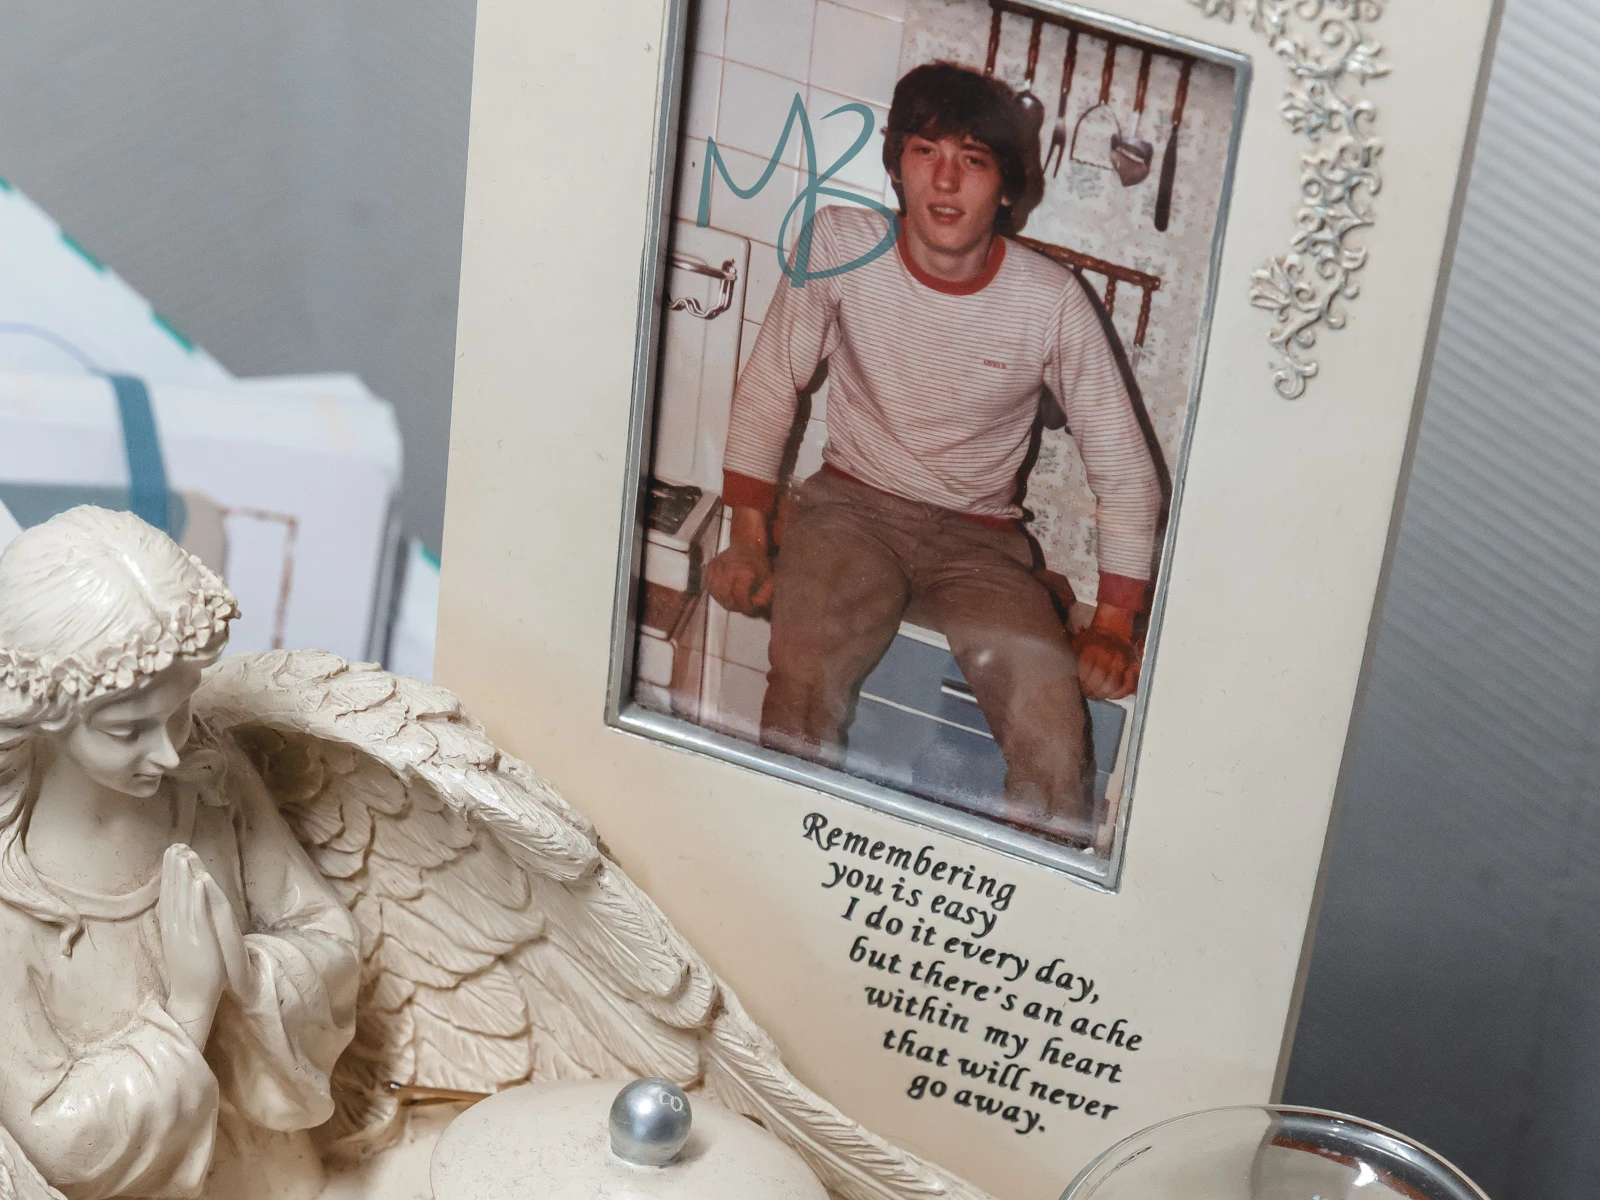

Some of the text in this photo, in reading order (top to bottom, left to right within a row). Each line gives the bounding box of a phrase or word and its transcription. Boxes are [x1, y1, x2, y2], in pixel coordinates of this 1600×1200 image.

[802, 812, 1017, 912] Remembering
[821, 861, 998, 939] you is easy
[840, 896, 1099, 1005] I do it every day,
[848, 935, 1143, 1052] but there's an ache
[864, 986, 1123, 1084] within my heart
[882, 1028, 1119, 1120] that will never
[905, 1074, 1046, 1135] go away.
